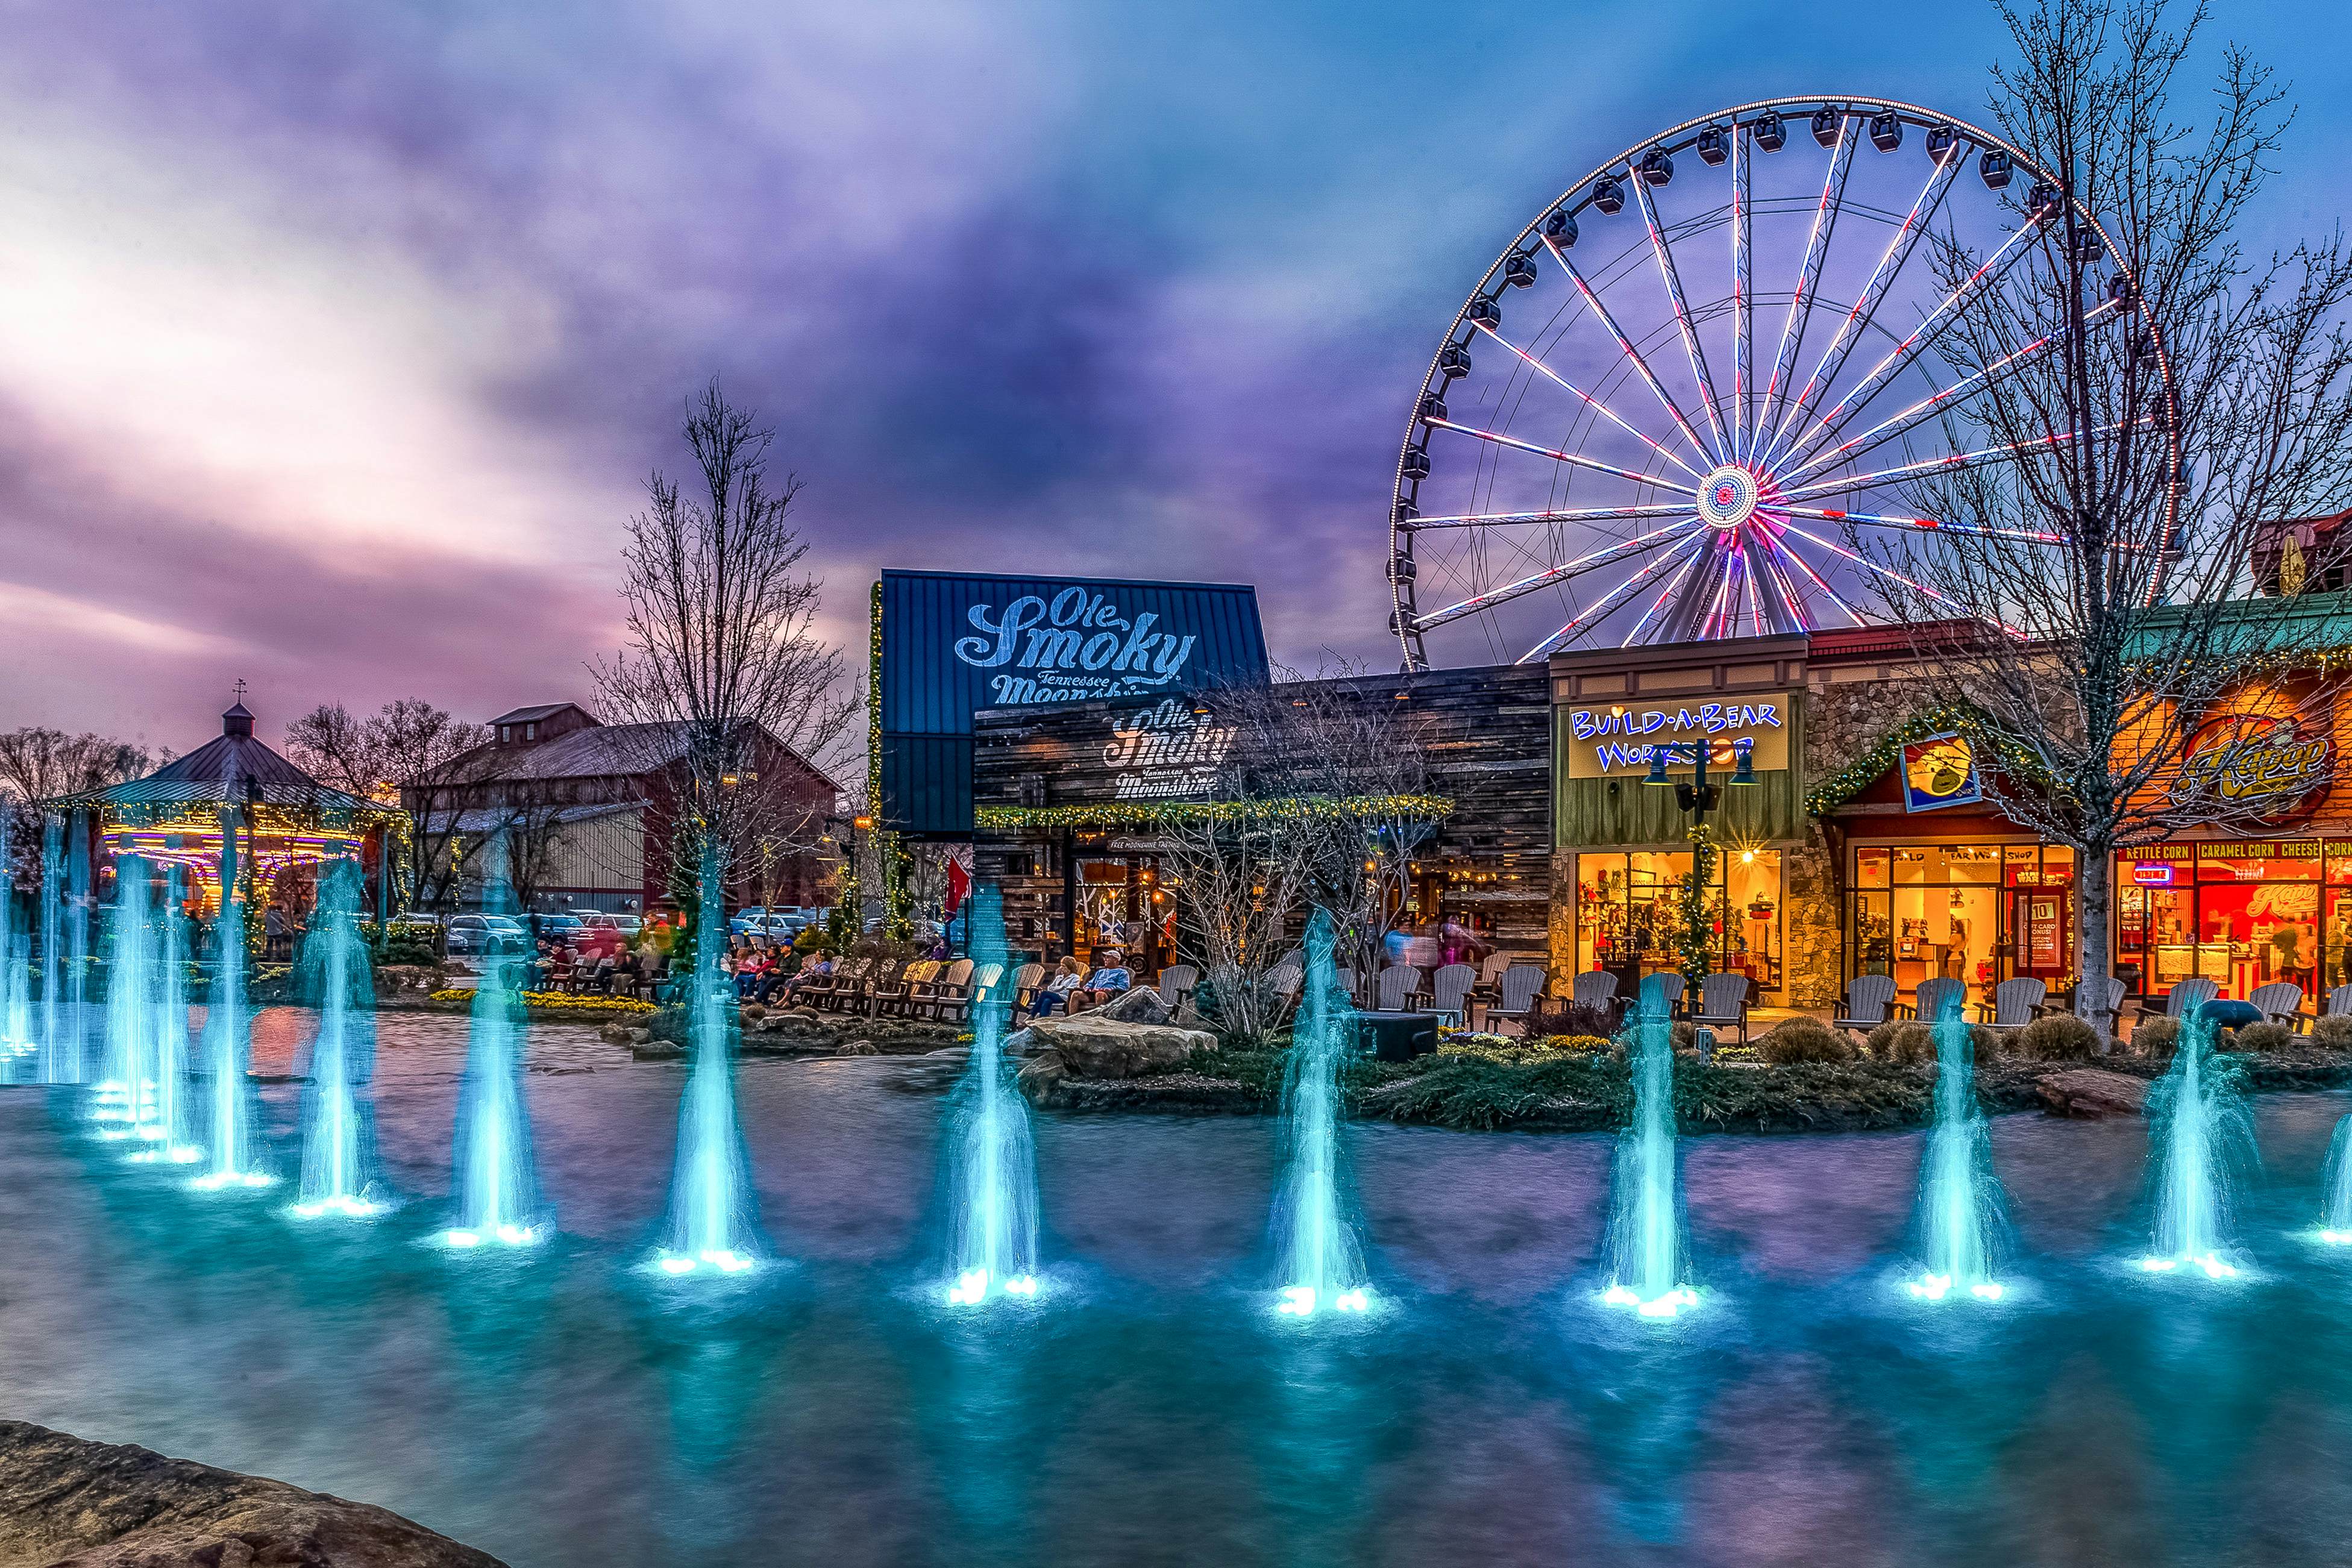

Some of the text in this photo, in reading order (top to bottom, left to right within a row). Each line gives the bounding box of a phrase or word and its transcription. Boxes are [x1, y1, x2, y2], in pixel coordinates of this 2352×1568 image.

[1050, 586, 1131, 632] Ole
[954, 595, 1197, 686] Smoky
[1037, 670, 1110, 688] Tennessee
[1153, 698, 1197, 730] Ole
[1103, 710, 1239, 774] Smoky
[1142, 767, 1184, 780] Tennessee
[1114, 773, 1218, 800] Moonshine
[2127, 846, 2189, 859] KETTLE CORN
[2201, 844, 2275, 858] CARAMEL CORN
[2281, 843, 2319, 856] CHEESE
[2133, 870, 2166, 879] OPEN
[2246, 883, 2316, 917] Kapo
